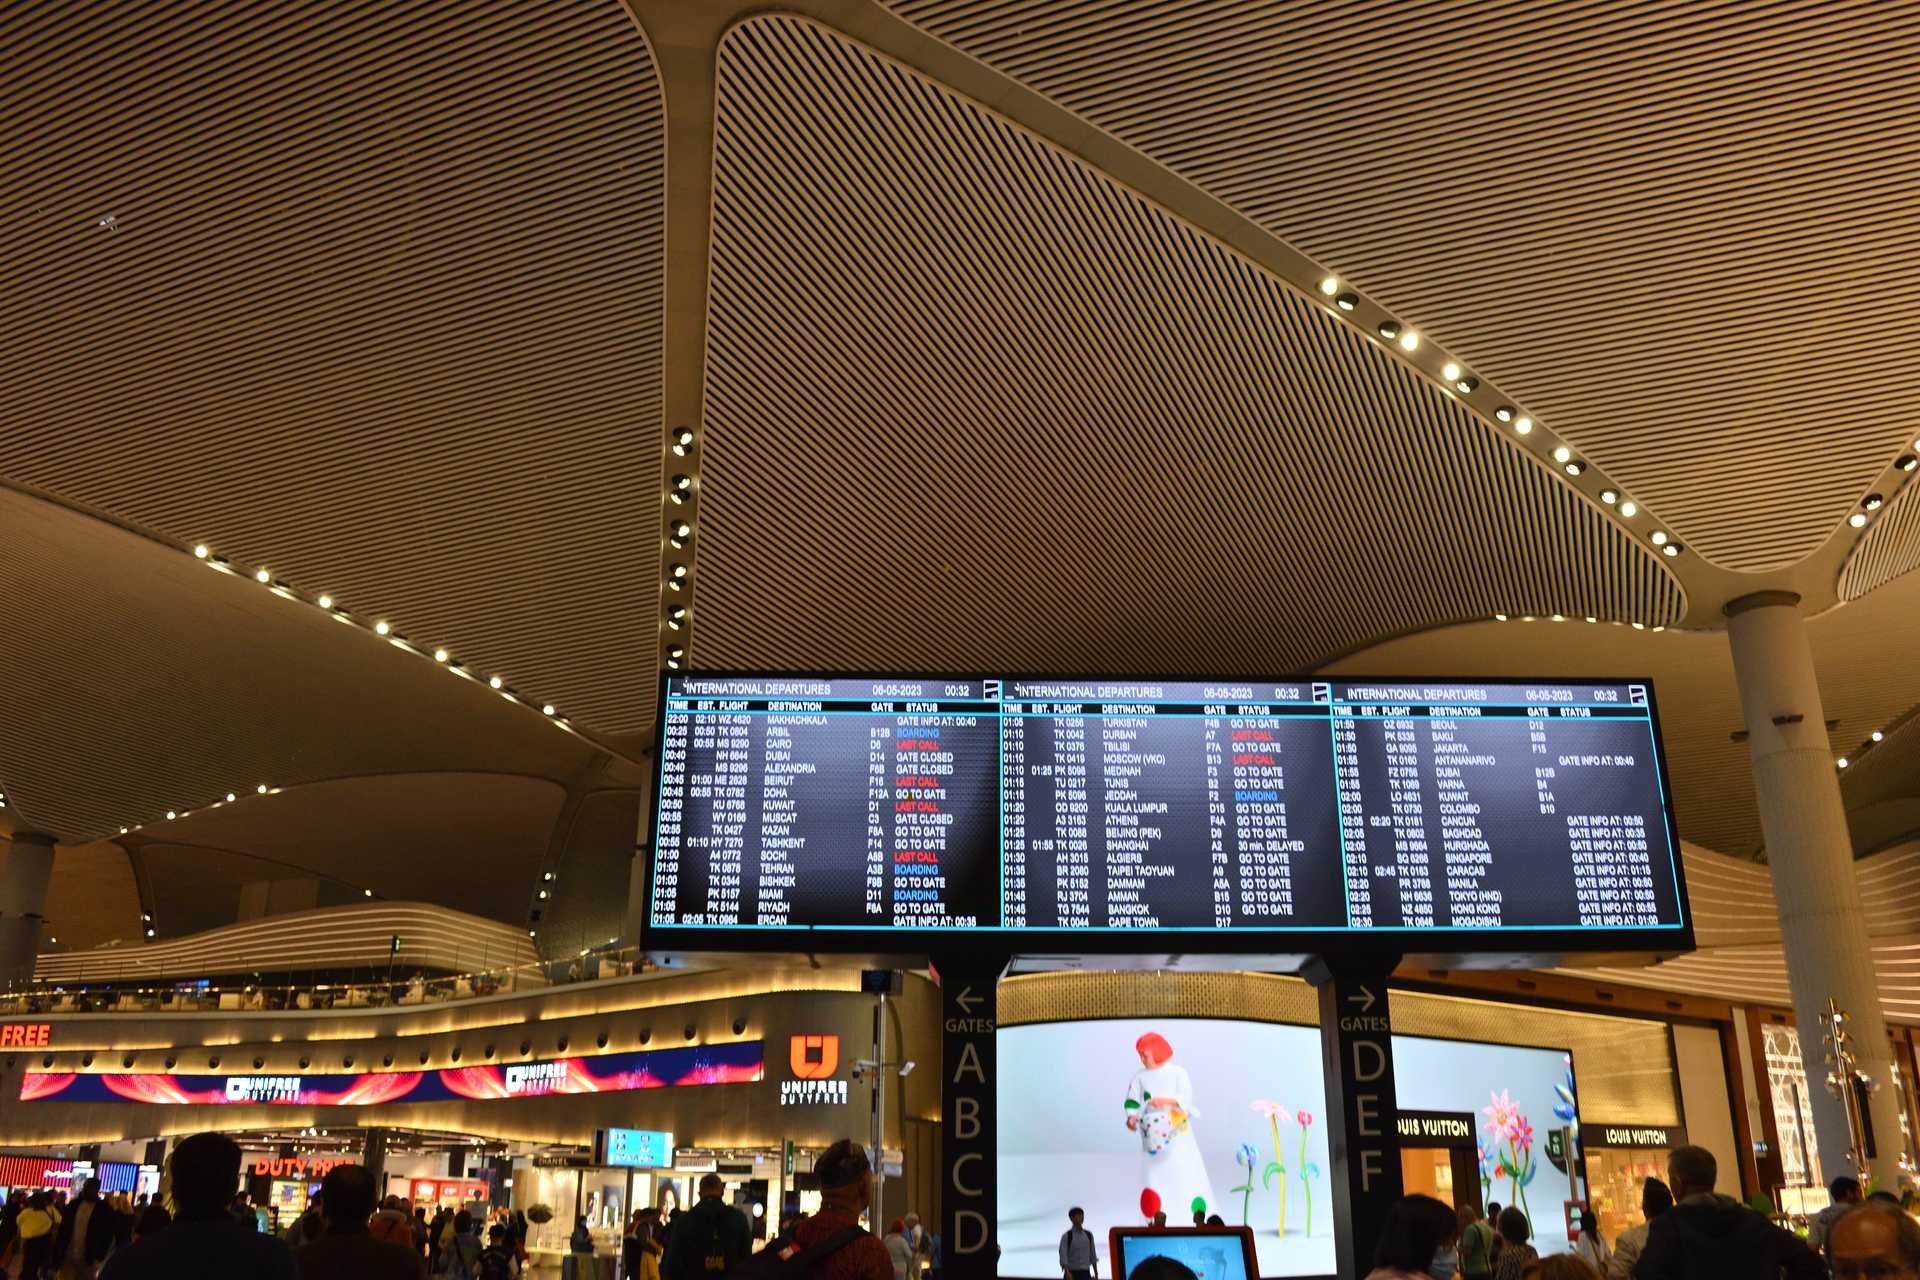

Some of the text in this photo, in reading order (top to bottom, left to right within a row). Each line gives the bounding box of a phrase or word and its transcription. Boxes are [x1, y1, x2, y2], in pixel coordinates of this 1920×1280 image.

[687, 683, 762, 694] INTERNATIONAL
[766, 684, 831, 695] DEPARTURES
[945, 685, 969, 697] 00:32
[1019, 686, 1095, 697] INTERNATIONAL
[1098, 687, 1162, 698] DEPARTURES
[1275, 688, 1299, 699] 00:32
[1348, 688, 1421, 700] INTERNATIONAL
[1424, 689, 1487, 700] DEPARTURES
[1594, 690, 1618, 701] 00:32
[669, 701, 938, 712] TIME EST. FLIGHT DESTINATION GATE STATUS
[1003, 704, 1270, 715] TIME EST. FLIGHT DESTINATION GATE STATUS
[1333, 707, 1591, 717] TIME EST. FLIGHT DESTINATION GATE STATUS
[1102, 718, 1148, 728] TURKISTAN
[767, 727, 790, 737] ARBIL
[1103, 730, 1136, 740] DURBAN
[766, 739, 792, 749] CAIRO
[1434, 744, 1468, 754] JAKARTA
[766, 751, 790, 761] DUBAI
[896, 752, 918, 762] GATE
[920, 752, 953, 762] CLOSED
[1104, 754, 1142, 764] MOSCOW
[765, 763, 953, 774] ALEXANDRIA GATE CLOSED
[1104, 766, 1141, 776] MEDINAH
[1234, 767, 1246, 777] GO
[1248, 767, 1260, 777] TO
[1261, 767, 1283, 777] GATE
[765, 776, 794, 786] BEIRUT
[1105, 778, 1128, 788] TUNIS
[1437, 780, 1465, 790] VARNA
[764, 788, 787, 798] DOHA
[1105, 790, 1137, 801] JEDDAH
[1438, 792, 1469, 802] KUWAIT
[763, 800, 795, 810] KUWAIT
[1105, 803, 1131, 813] KUALA
[1133, 803, 1168, 814] LUMPUR
[1440, 804, 1480, 814] COLOMBO
[763, 813, 797, 823] MUSCAT
[895, 814, 917, 824] GATE
[920, 814, 953, 825] CLOSED
[1106, 815, 1138, 826] ATHENS
[1441, 816, 1475, 826] CANCUN
[762, 825, 789, 836] KAZAN
[1106, 828, 1161, 840] BEIJING (PEK)
[1443, 828, 1482, 839] BAGHDAD
[762, 838, 805, 848] TASHKENT
[895, 839, 908, 849] GO
[910, 839, 921, 849] TO
[923, 839, 946, 850] GATE
[1106, 840, 1149, 851] SHANGHAI
[1267, 841, 1304, 851] DELAYED
[1444, 841, 1490, 851] HURGHADA
[761, 850, 787, 861] SOCHI
[1107, 853, 1142, 864] ALGIERS
[1445, 853, 1493, 864] SINGAPORE
[760, 863, 794, 874] TEHRAN
[894, 864, 938, 875] BOARDING
[1107, 866, 1175, 877] TAIPEI TAOYUAN
[1447, 866, 1485, 876] CARACAS
[760, 876, 795, 887] BISHKEK
[1108, 878, 1145, 889] DAMMAM
[1448, 878, 1478, 889] MANILA
[759, 889, 783, 900] MIAMI
[894, 890, 938, 901] BOARDING
[1108, 891, 1139, 902] AMMAN
[1449, 891, 1478, 902] TOKYO
[758, 902, 790, 913] RIYADH
[1108, 904, 1150, 915] BANGKOK
[1451, 904, 1500, 915] HONG KONG
[758, 915, 787, 925] ERCAN
[1109, 917, 1131, 928] CAPE
[1133, 917, 1159, 928] TOWN
[946, 1018, 994, 1033] GATES
[1341, 1017, 1388, 1031] GATES
[1, 1024, 51, 1048] FREE
[953, 1042, 986, 1083] A
[1353, 1040, 1386, 1081] D
[781, 1080, 848, 1094] UNIFREE
[780, 1093, 847, 1105] DUTYFREE
[954, 1097, 982, 1139] B
[1357, 1096, 1382, 1136] E
[1398, 1119, 1469, 1137] UIS VUITTON
[1606, 1128, 1668, 1145] LOUIS VUITTON
[255, 1157, 308, 1177] DUTY
[1360, 1150, 1382, 1193] F
[952, 1153, 983, 1196] C
[954, 1210, 989, 1254] D
